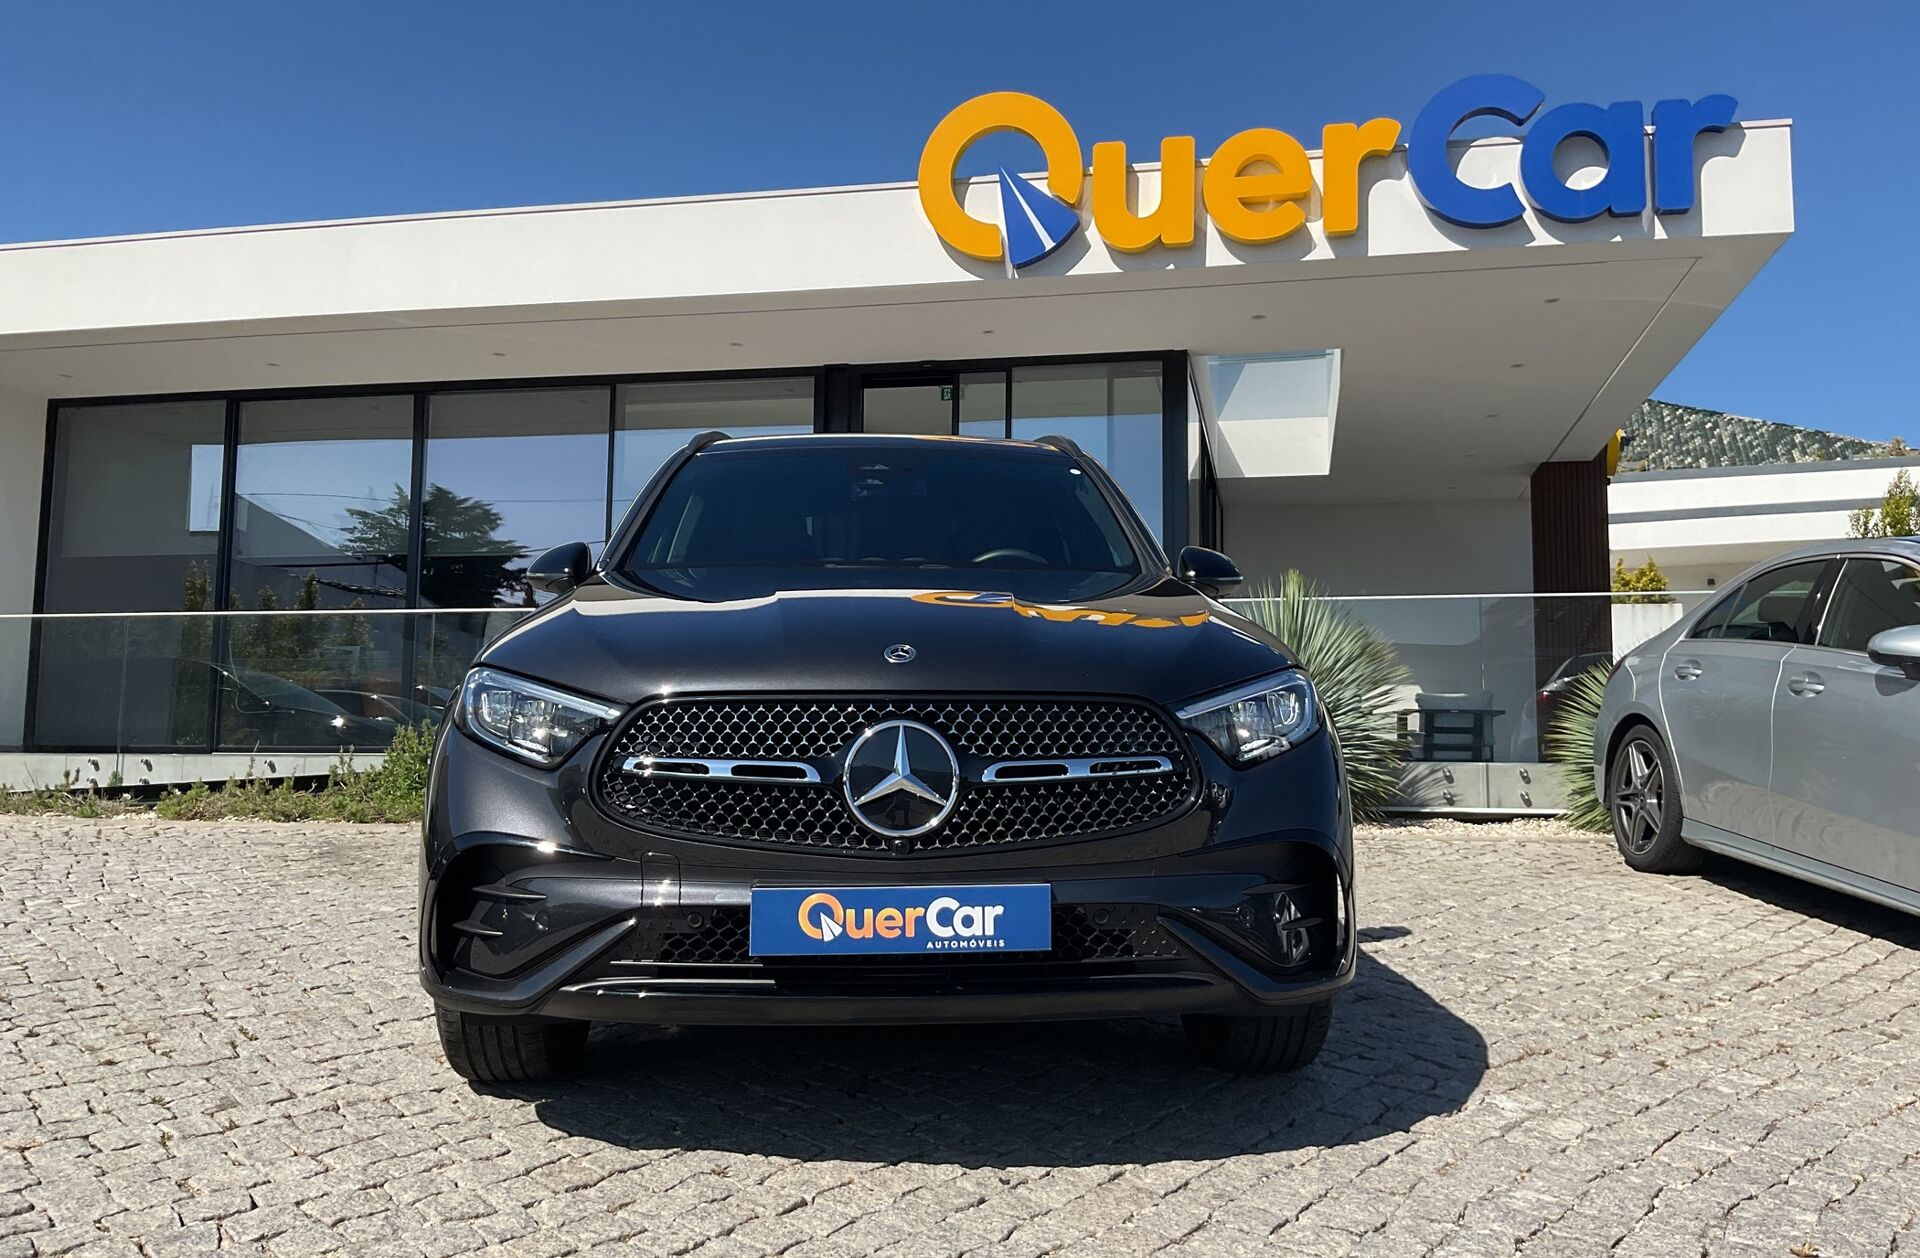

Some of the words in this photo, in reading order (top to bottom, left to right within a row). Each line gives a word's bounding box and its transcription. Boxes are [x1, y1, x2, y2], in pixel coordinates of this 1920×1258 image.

[917, 74, 1738, 268] QuerCar
[798, 893, 1004, 942] QuerCar
[926, 938, 1005, 949] AUTOMÓVEIS
